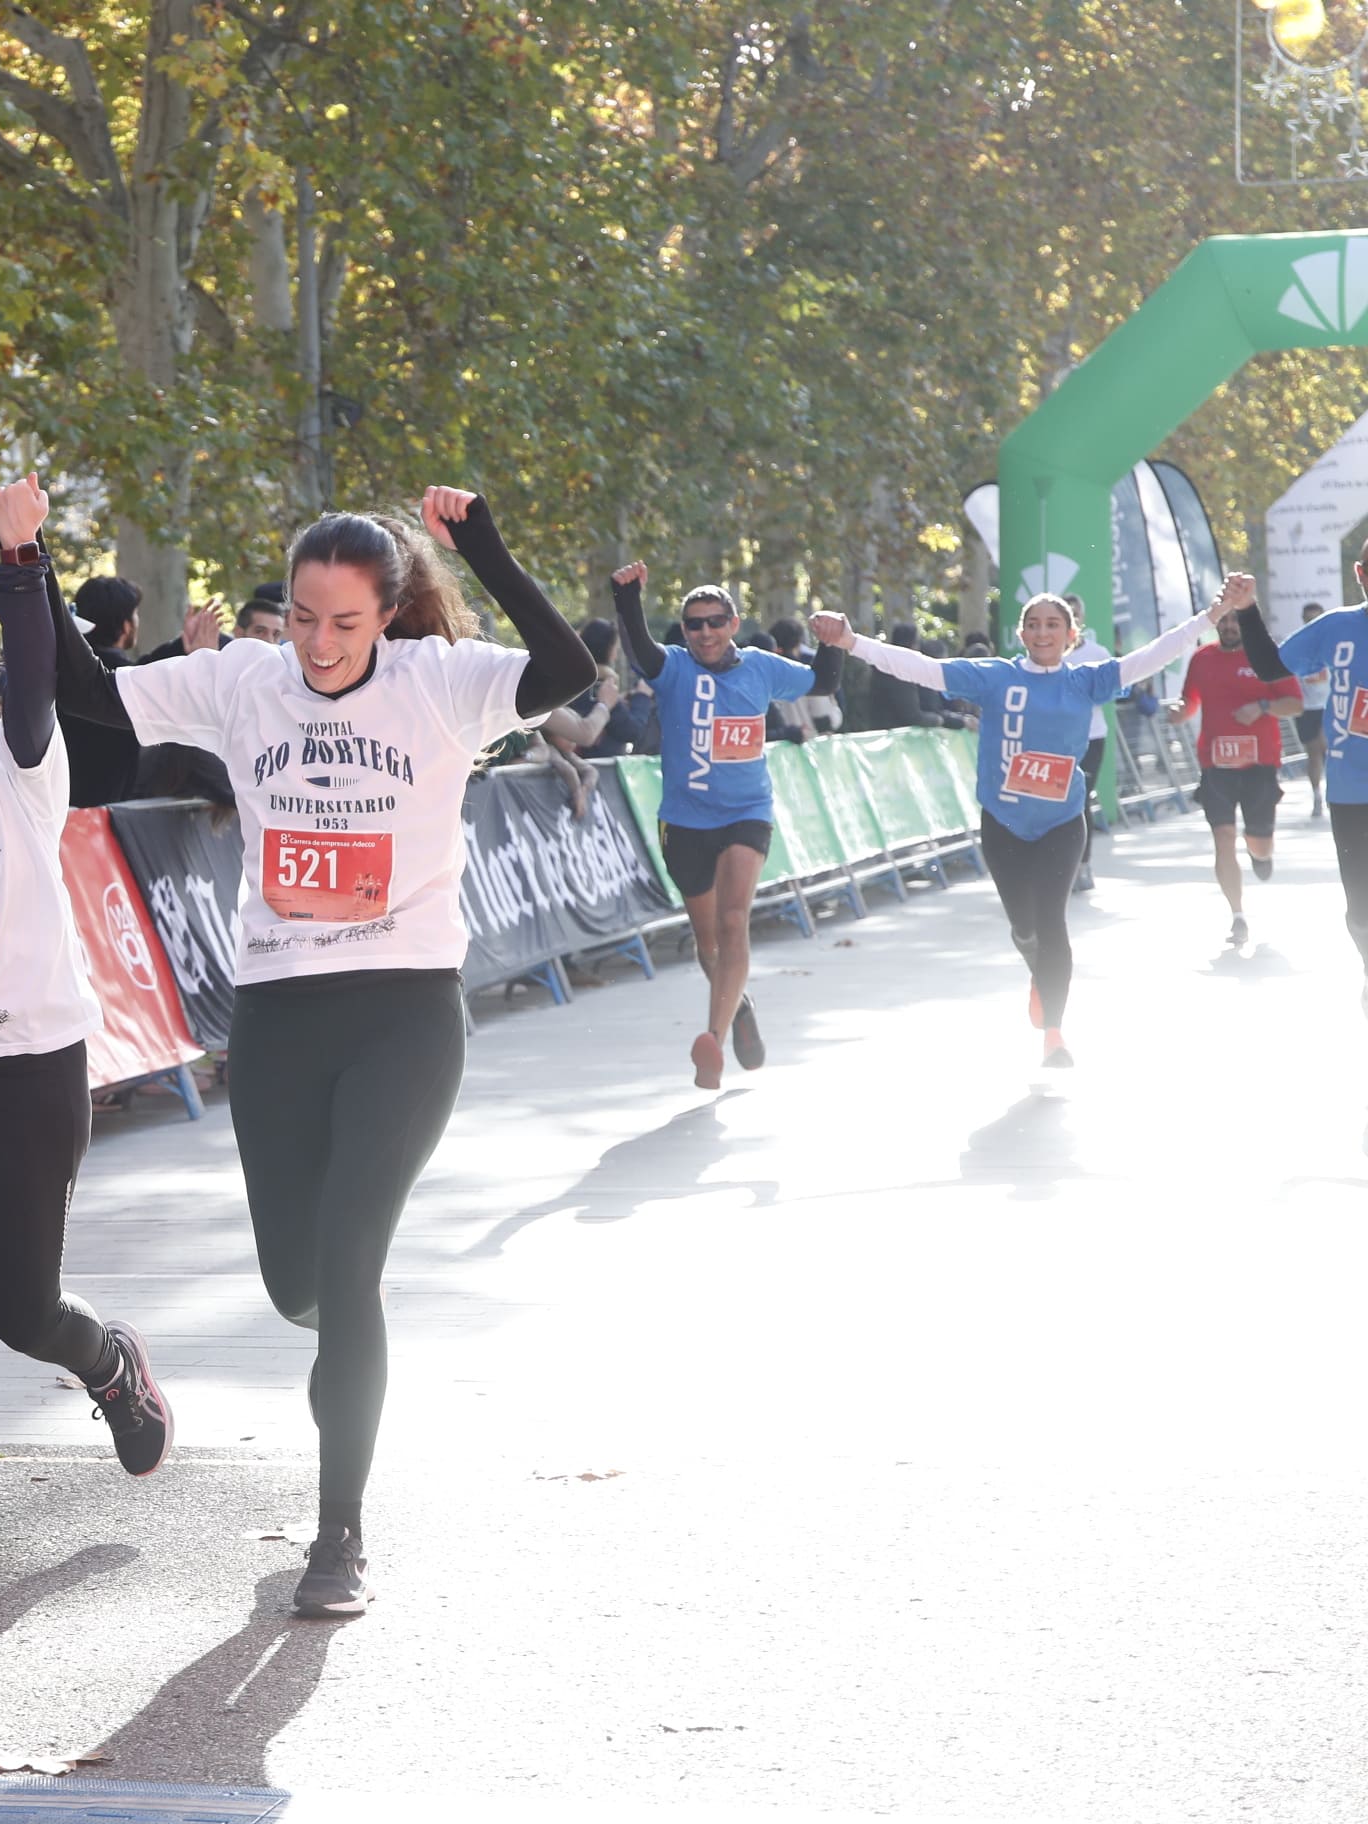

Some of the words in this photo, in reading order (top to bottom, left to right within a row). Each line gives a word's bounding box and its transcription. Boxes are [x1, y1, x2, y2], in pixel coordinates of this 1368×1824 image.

[1331, 641, 1355, 759] IVECO
[688, 673, 716, 791] IVECO
[720, 725, 751, 746] 742
[254, 741, 291, 788] RIO
[301, 736, 414, 787] HORTEGA
[1018, 759, 1051, 783] 744
[270, 794, 396, 815] UNIVERSITARIO
[314, 817, 349, 830] 1953
[290, 837, 312, 846] Carrera
[312, 839, 320, 847] de
[352, 840, 376, 848] Adecco
[277, 846, 338, 889] 521
